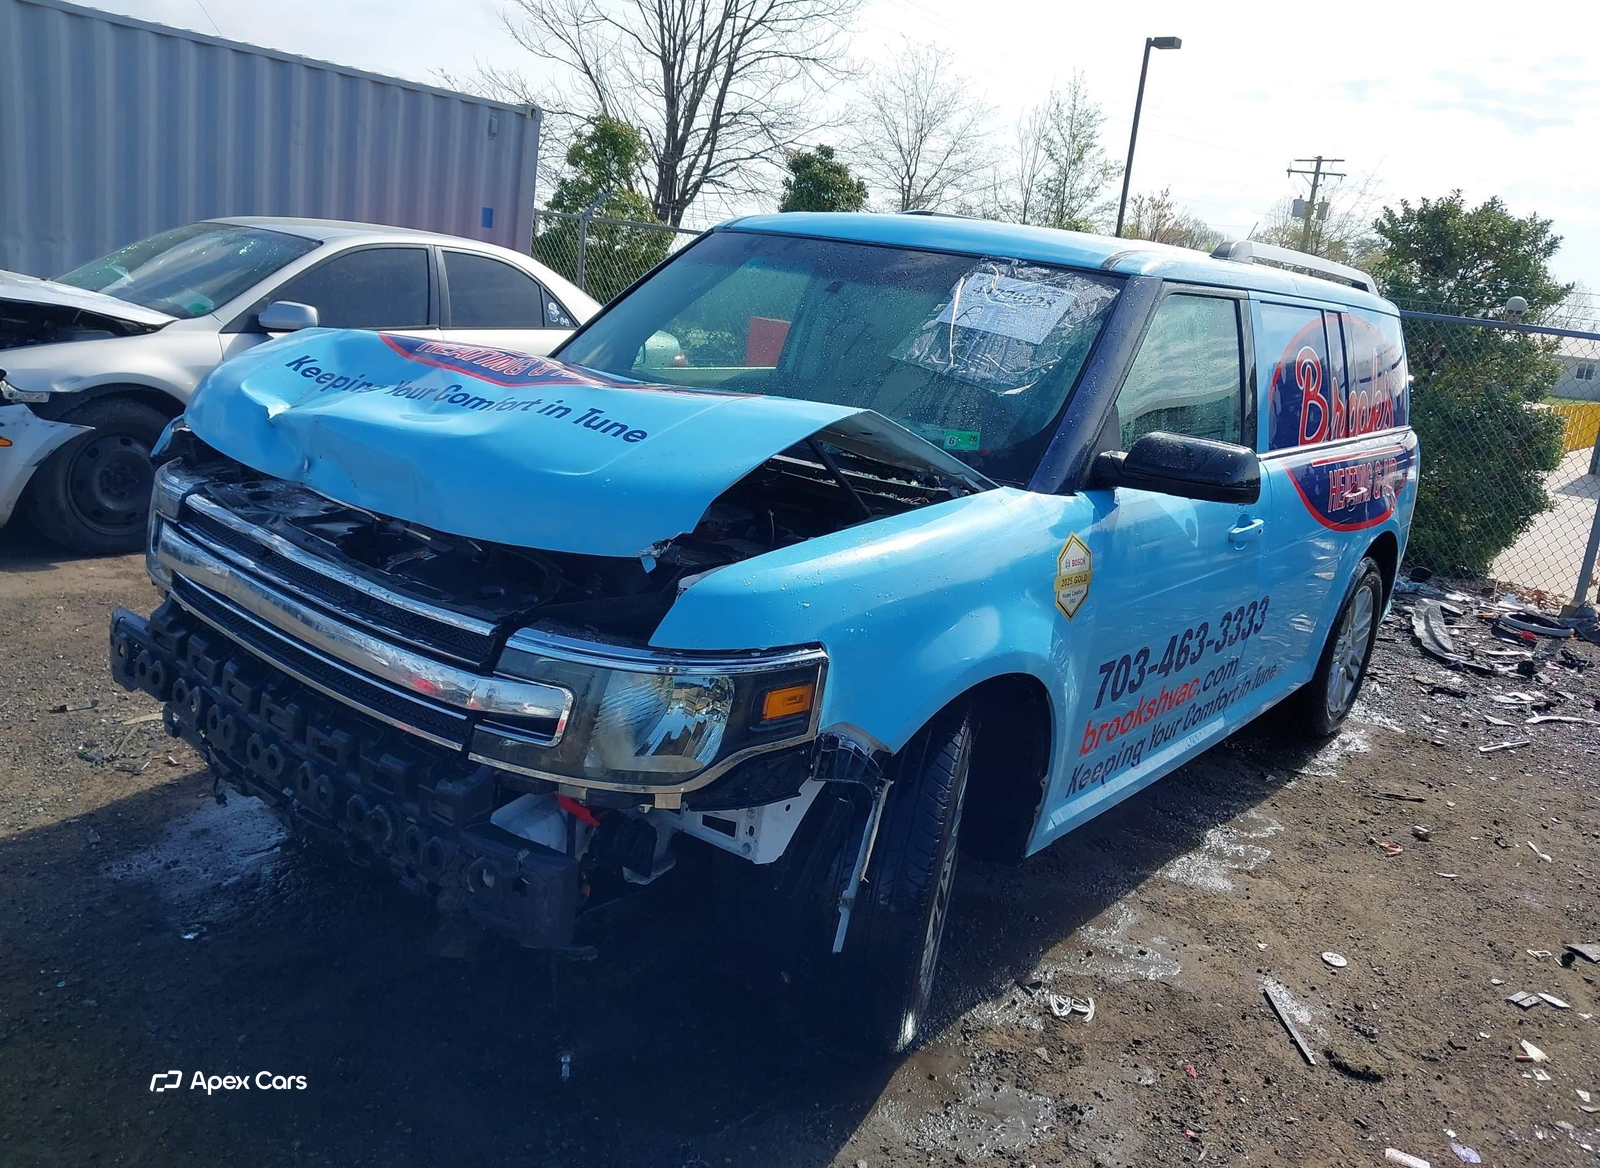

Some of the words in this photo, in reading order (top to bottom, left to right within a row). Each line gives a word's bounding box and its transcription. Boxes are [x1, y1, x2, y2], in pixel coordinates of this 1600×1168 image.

[386, 380, 436, 401] Your
[434, 385, 543, 412] Comfort
[539, 399, 574, 420] in
[572, 407, 649, 444] Tune
[948, 436, 956, 445] 6
[1061, 576, 1074, 588] 2025
[1074, 573, 1088, 584] GOLD
[1071, 558, 1086, 568] BOSCH
[1094, 595, 1270, 711] 703-463-3333
[1065, 738, 1147, 799] Keeping
[1147, 716, 1184, 752] Your
[1182, 687, 1241, 731] Comfort
[1238, 674, 1252, 700] in
[1251, 664, 1278, 692] Tune
[1079, 657, 1239, 758] brookshvac.com
